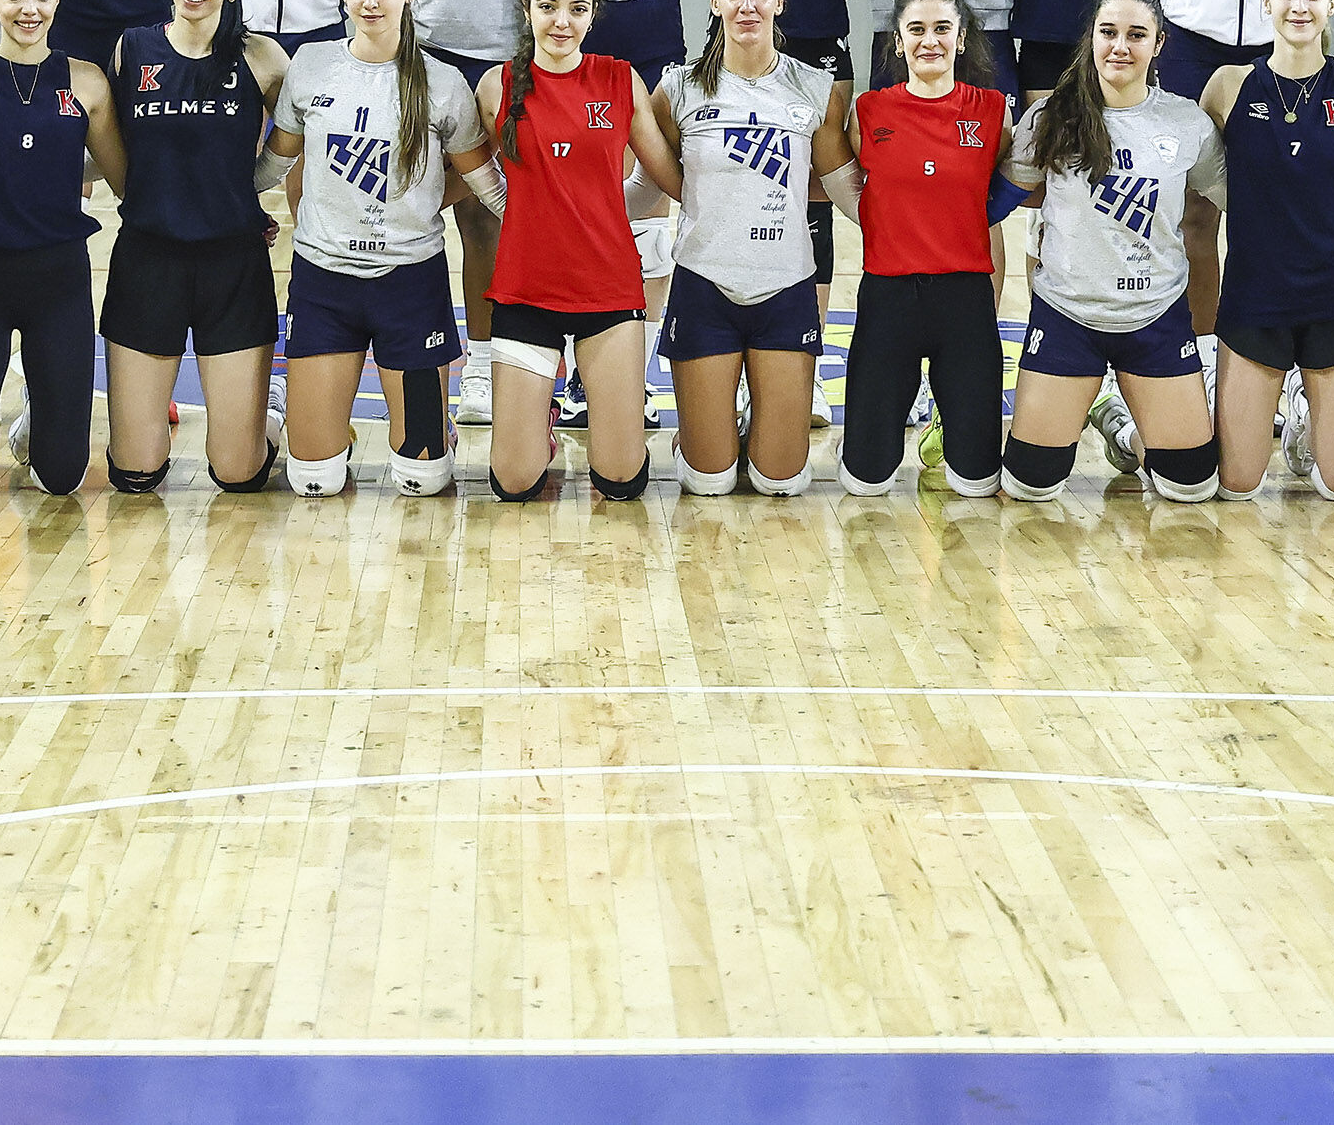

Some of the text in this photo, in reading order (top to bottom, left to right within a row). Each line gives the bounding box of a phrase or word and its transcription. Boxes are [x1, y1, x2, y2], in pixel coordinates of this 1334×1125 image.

[138, 64, 165, 91] K
[56, 88, 82, 117] K
[133, 101, 216, 119] KELME
[354, 107, 369, 132] 11
[586, 102, 613, 129] K
[1248, 112, 1270, 121] umbro
[22, 134, 33, 149] 8
[957, 120, 984, 148] K
[552, 143, 571, 157] 17
[1290, 142, 1302, 156] 7
[1115, 149, 1133, 170] 18
[924, 161, 935, 175] 5
[750, 227, 784, 240] 2007
[349, 240, 386, 252] 2007
[1117, 277, 1151, 291] 2007
